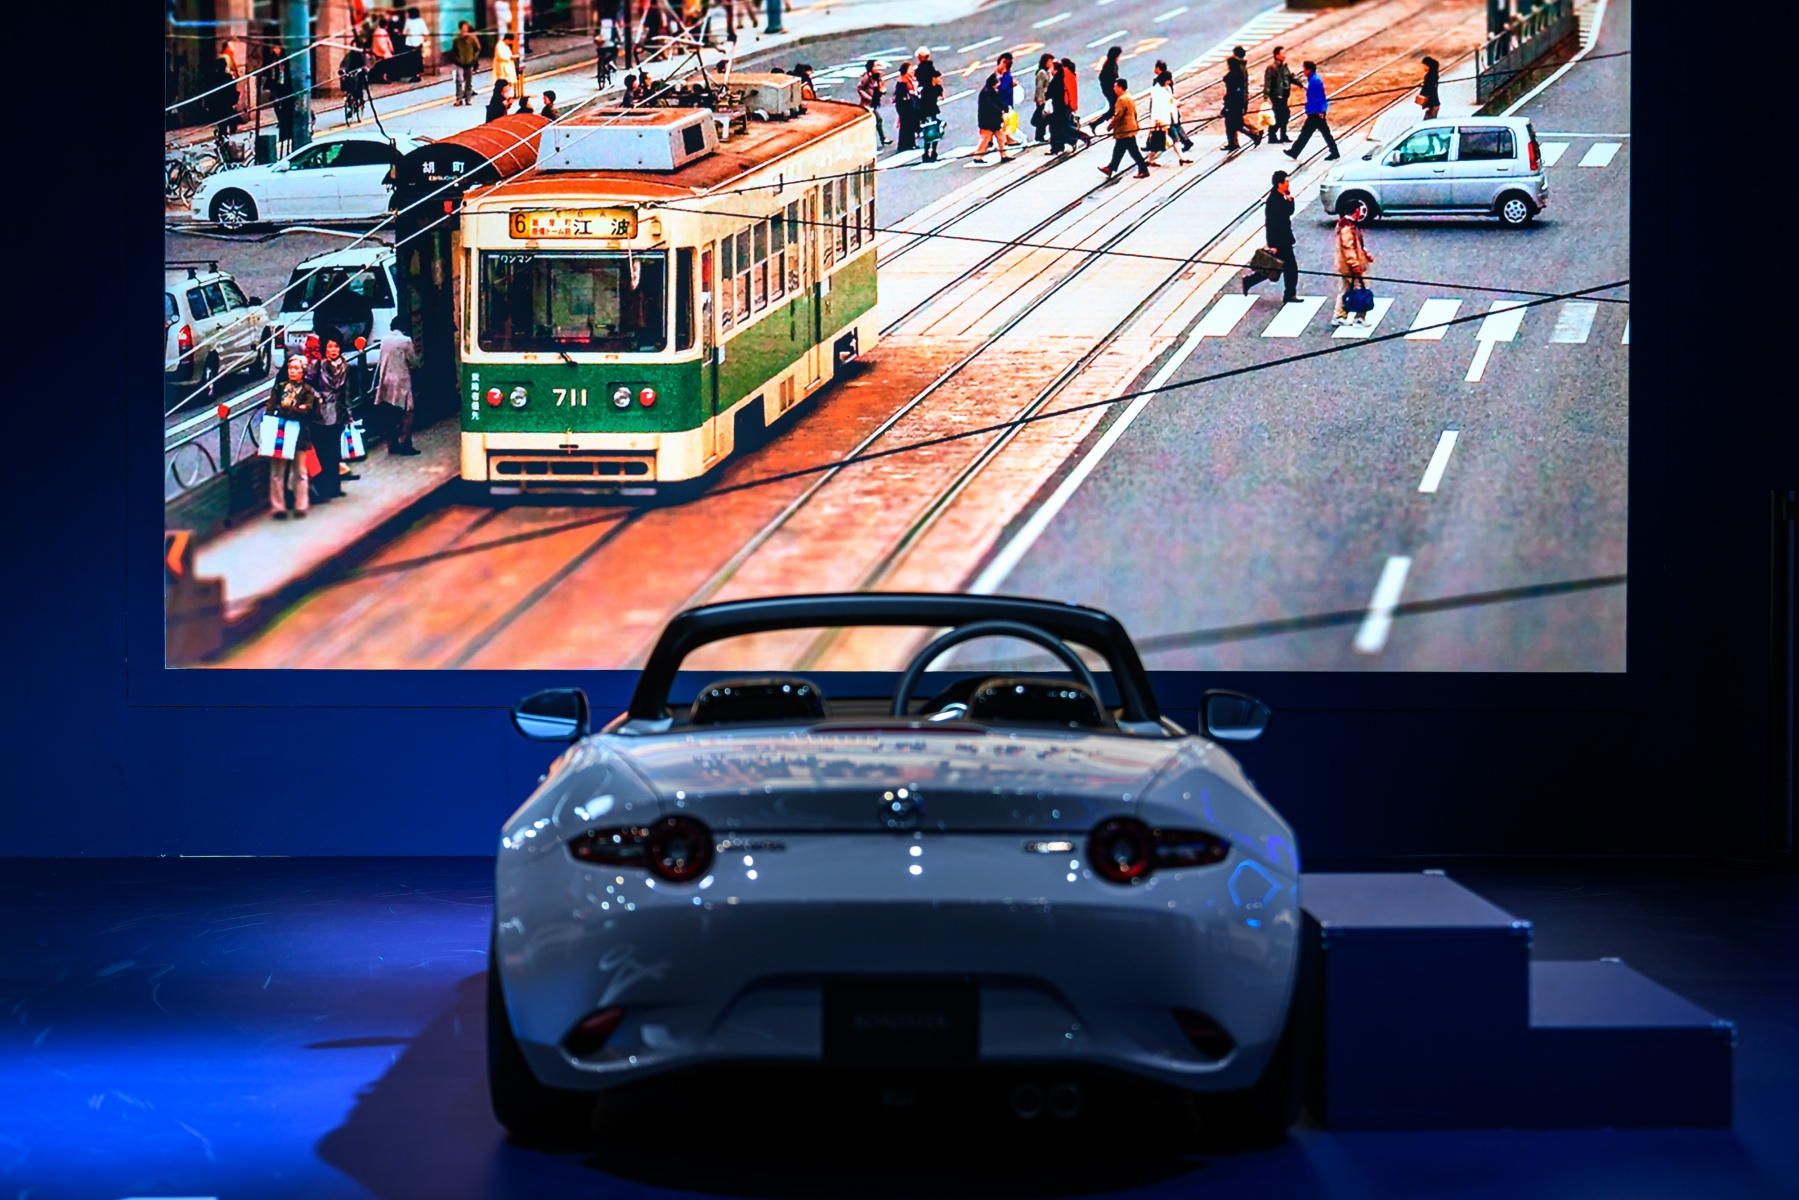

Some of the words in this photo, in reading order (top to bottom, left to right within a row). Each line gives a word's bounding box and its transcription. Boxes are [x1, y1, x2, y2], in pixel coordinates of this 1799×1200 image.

[515, 213, 526, 234] 6
[500, 255, 532, 263] ワンマン
[552, 388, 587, 407] 711
